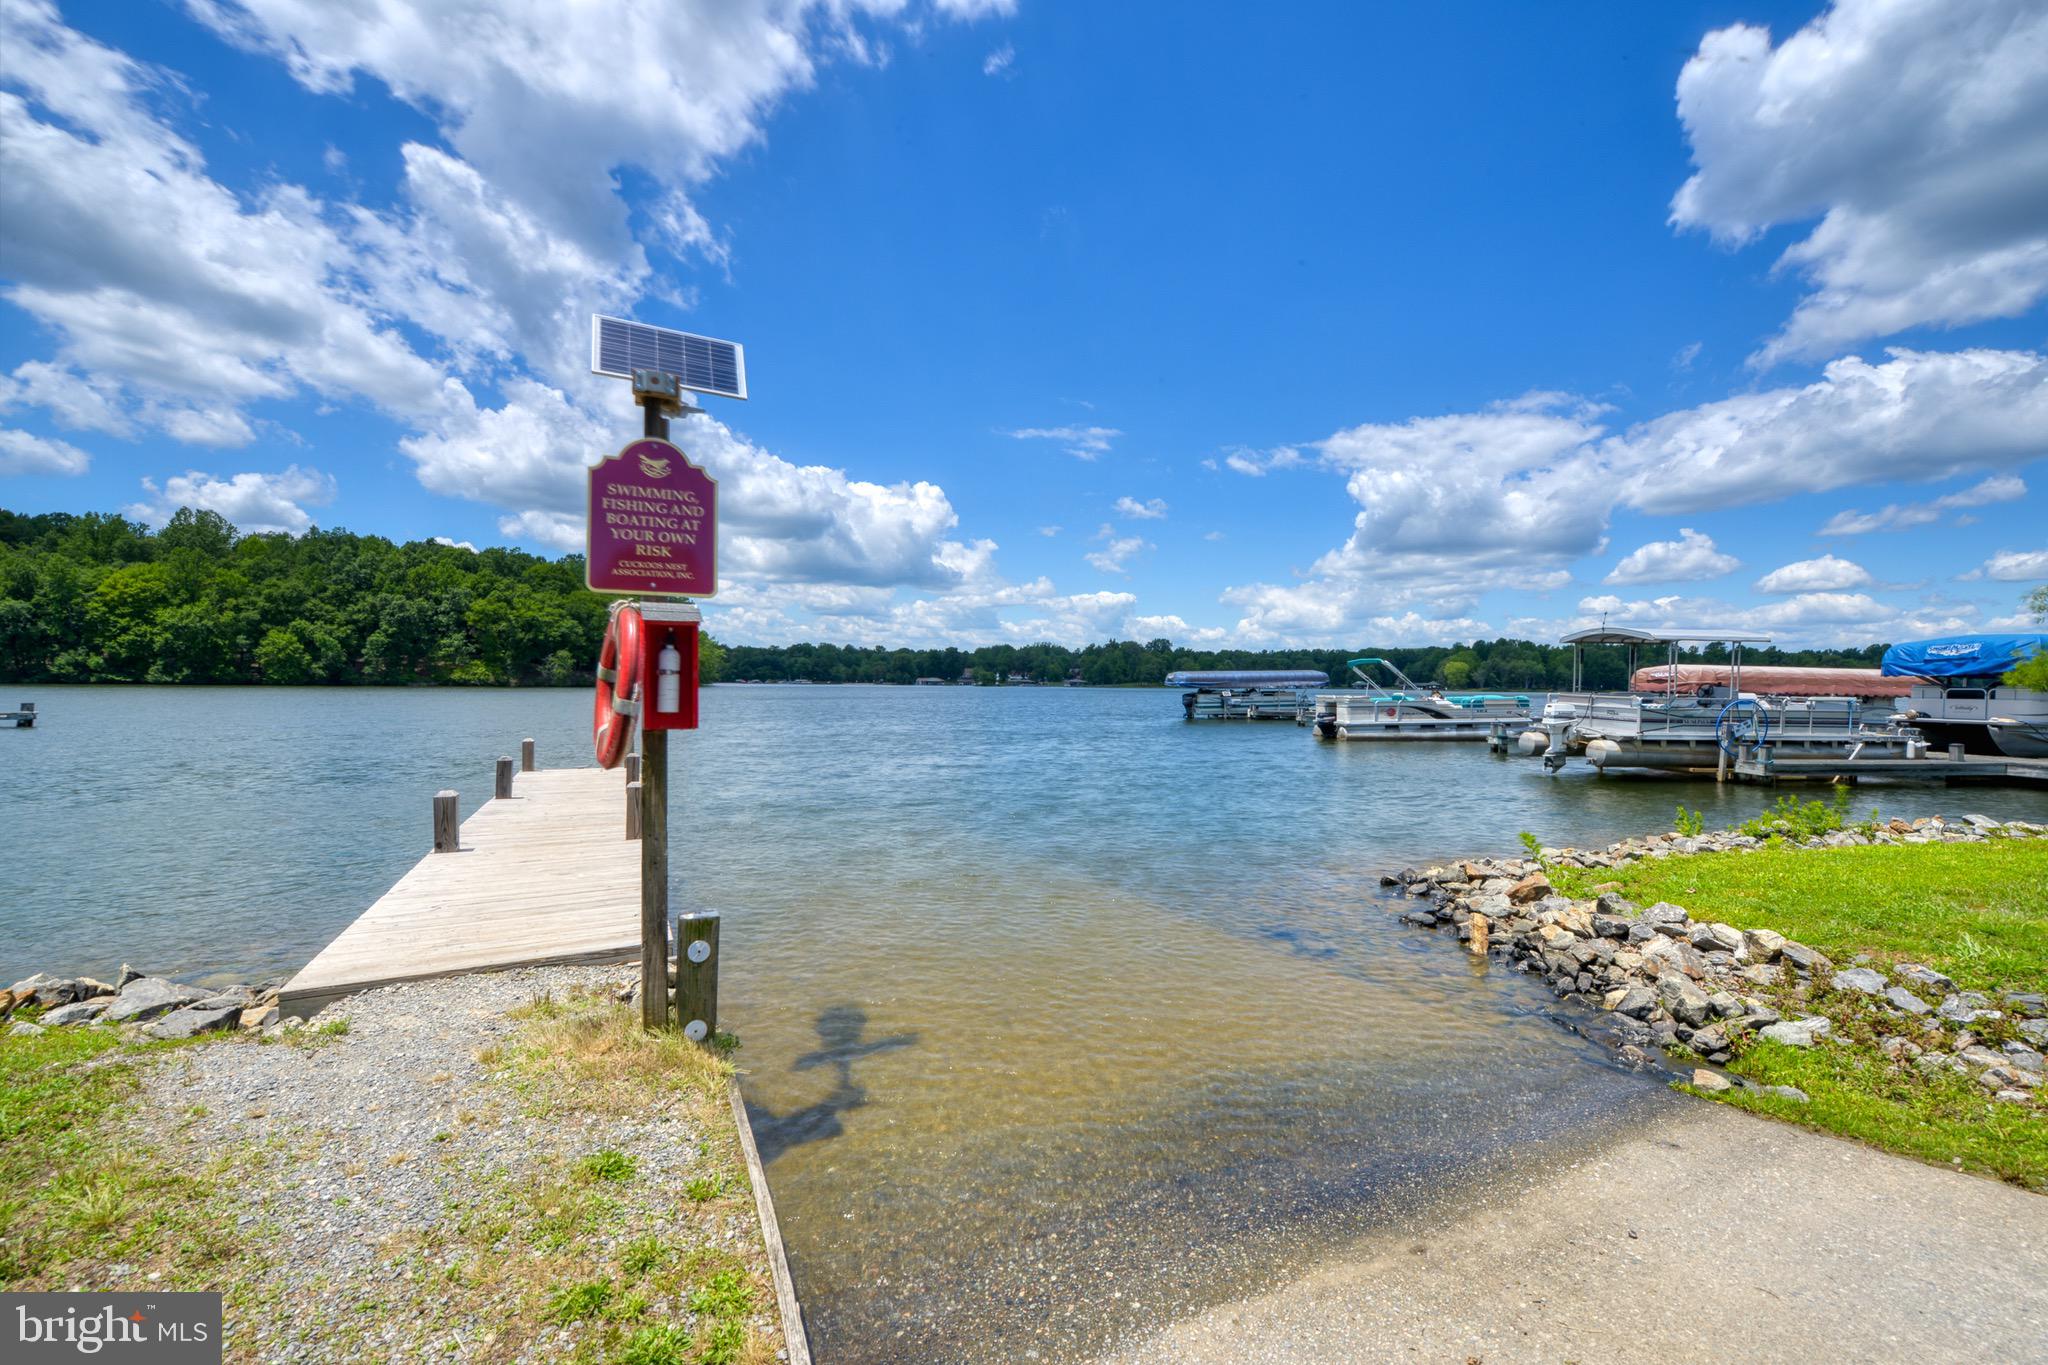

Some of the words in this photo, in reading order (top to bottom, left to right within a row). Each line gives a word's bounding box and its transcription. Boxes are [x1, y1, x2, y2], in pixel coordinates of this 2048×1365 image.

[602, 497, 668, 514] FISHING
[670, 505, 705, 518] AND
[606, 512, 679, 529] BOATING
[681, 520, 701, 531] AT
[610, 528, 655, 542] YOUR
[659, 531, 696, 545] OWN
[636, 545, 672, 557] RISK
[619, 560, 664, 569] CUCKOOS
[665, 562, 687, 571] NEST
[676, 572, 695, 580] INC.
